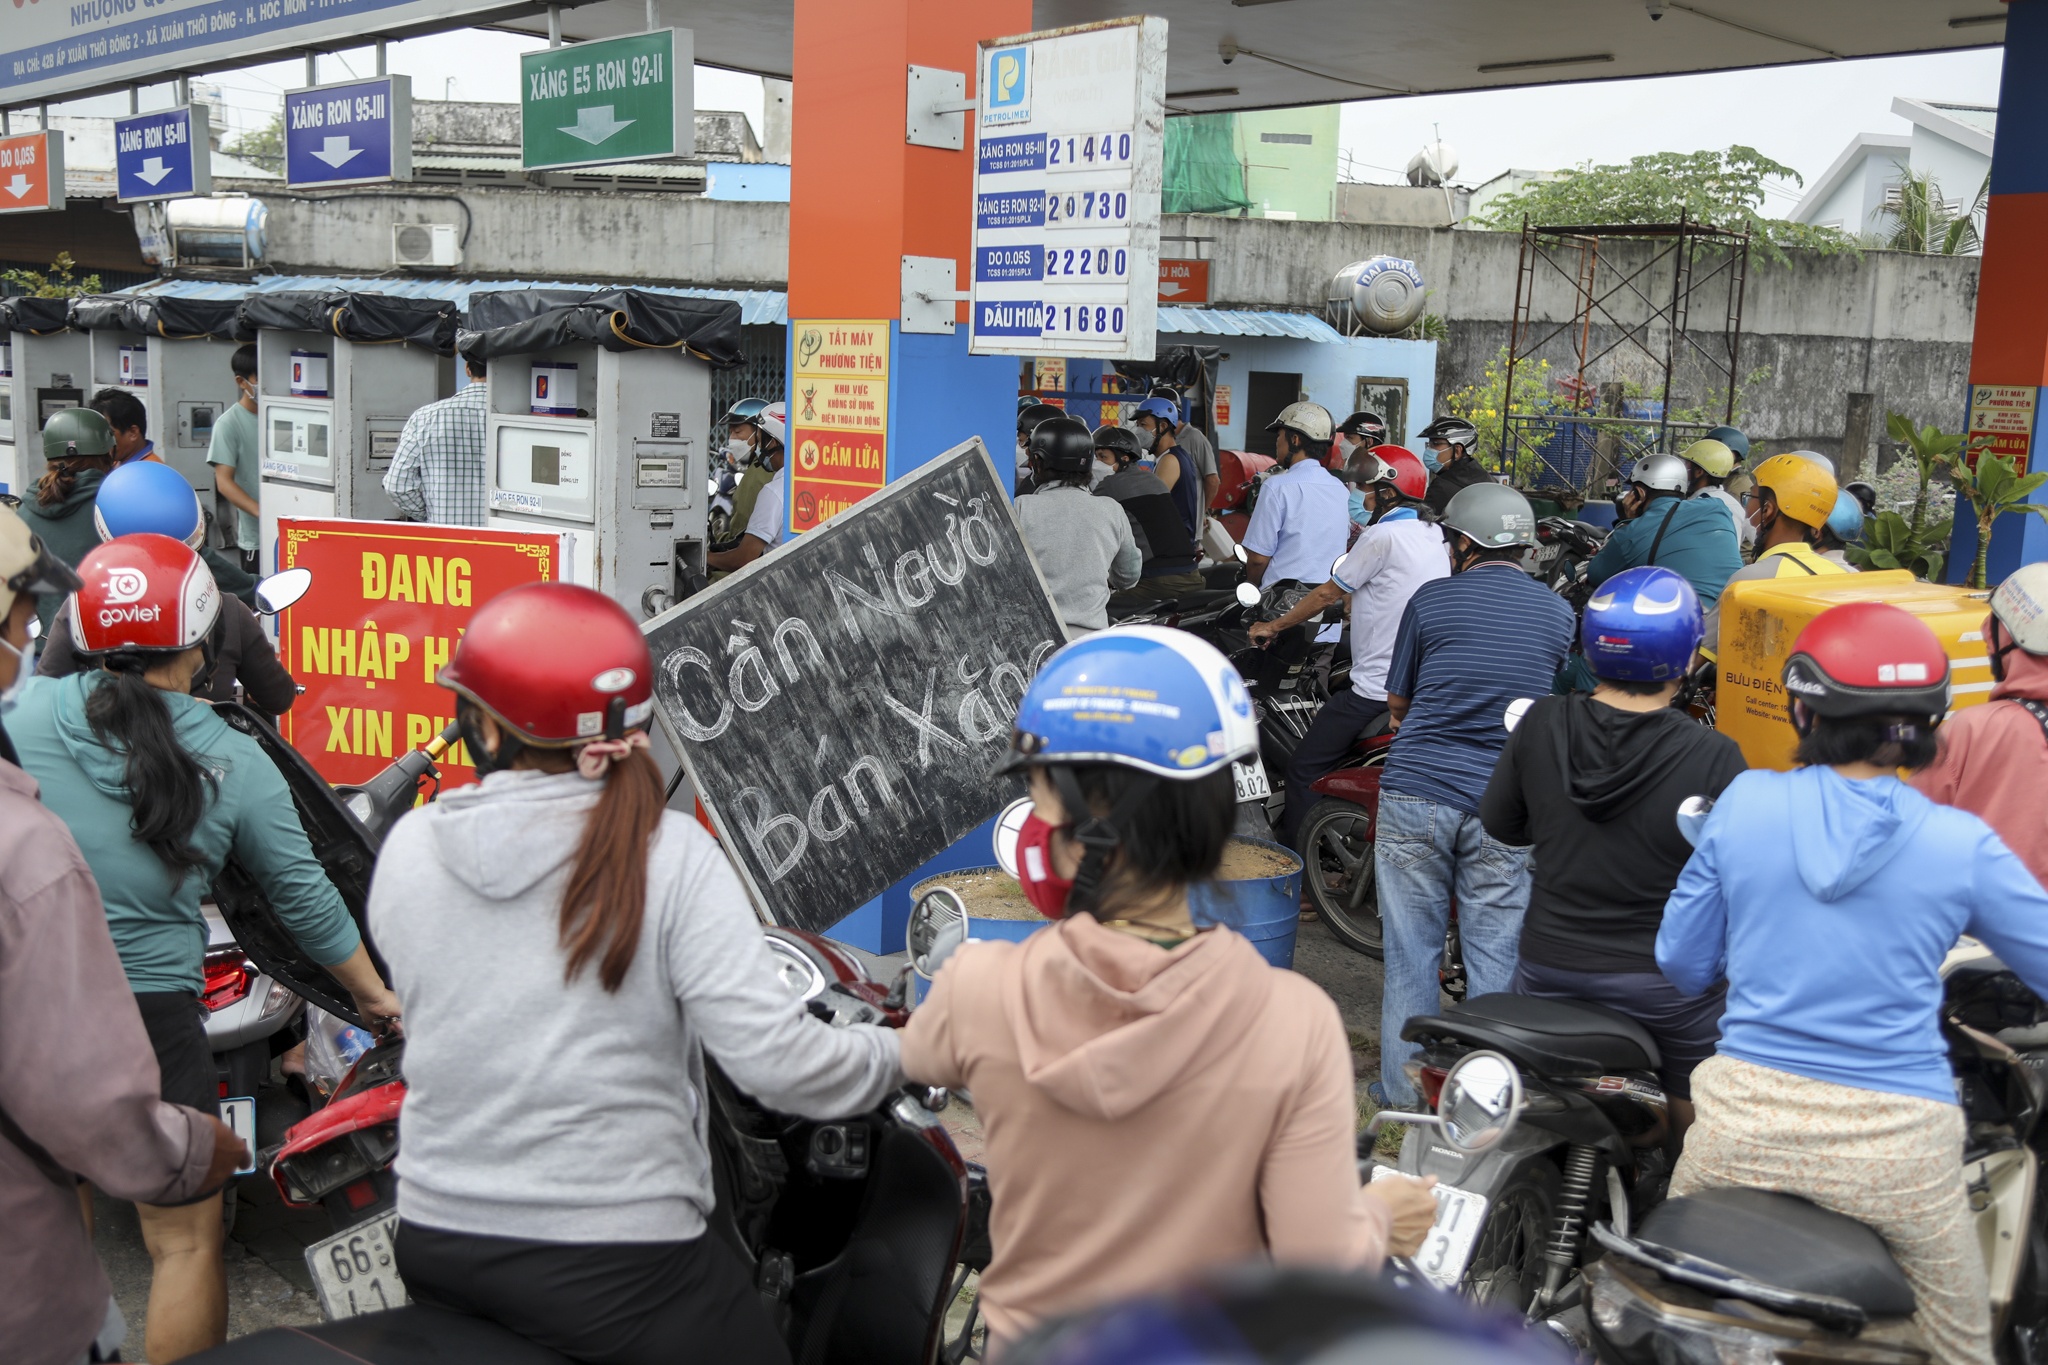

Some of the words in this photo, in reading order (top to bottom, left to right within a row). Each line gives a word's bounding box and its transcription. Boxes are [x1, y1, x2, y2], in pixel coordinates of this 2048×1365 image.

[42, 56, 54, 69] 42B
[68, 43, 88, 64] XUÂN
[133, 33, 139, 49] 2
[160, 20, 184, 42] XUÂN
[211, 10, 236, 33] ĐÔNG
[530, 65, 568, 102] XĂNG
[573, 64, 591, 95] E5
[596, 58, 627, 92] RON
[632, 53, 663, 87] 92-II
[292, 100, 323, 130] XĂNG
[327, 99, 351, 126] RON
[355, 94, 385, 122] 95-III
[984, 109, 1030, 124] PETROLIMEX
[119, 127, 143, 153] XĂNG
[144, 126, 163, 150] RON
[165, 121, 187, 146] 95-III
[981, 143, 1004, 160] XĂNG
[1005, 143, 1024, 157] RON
[1025, 140, 1045, 156] 95-III
[1049, 133, 1131, 165] 21440
[1, 149, 12, 168] DO
[978, 197, 999, 216] XĂNG
[1000, 199, 1010, 215] E5
[1011, 198, 1028, 214] RON
[1049, 191, 1127, 221] 20730
[988, 251, 1003, 266] DO
[1004, 250, 1031, 265] 0.05S
[1047, 248, 1126, 276] 22200
[1015, 301, 1043, 328] HỎA
[1045, 305, 1124, 334] 21680
[829, 327, 848, 346] TẮT
[850, 327, 874, 346] MÁY
[819, 354, 856, 369] PHƯƠNG
[859, 353, 882, 372] TIỆN
[834, 384, 850, 395] KHU
[854, 384, 868, 395] VỰC
[821, 414, 836, 424] ĐIỆN
[837, 415, 855, 426] THOẠI
[856, 415, 863, 425] DI
[864, 416, 880, 427] ĐỘNG
[822, 441, 852, 467] CẤM
[855, 443, 880, 470] LỬA
[361, 551, 472, 607] ĐANG
[100, 604, 162, 628] goviet
[302, 620, 411, 689] NHẬP
[658, 616, 825, 742] Cần
[1726, 672, 1750, 687] BƯU
[1752, 678, 1783, 696] ĐIỆN
[1745, 695, 1758, 706] Call
[1758, 698, 1779, 710] center:
[1745, 706, 1771, 719] Website:
[325, 705, 393, 758] XIN
[732, 734, 896, 885] Bán
[1430, 1145, 1464, 1160] HONDA
